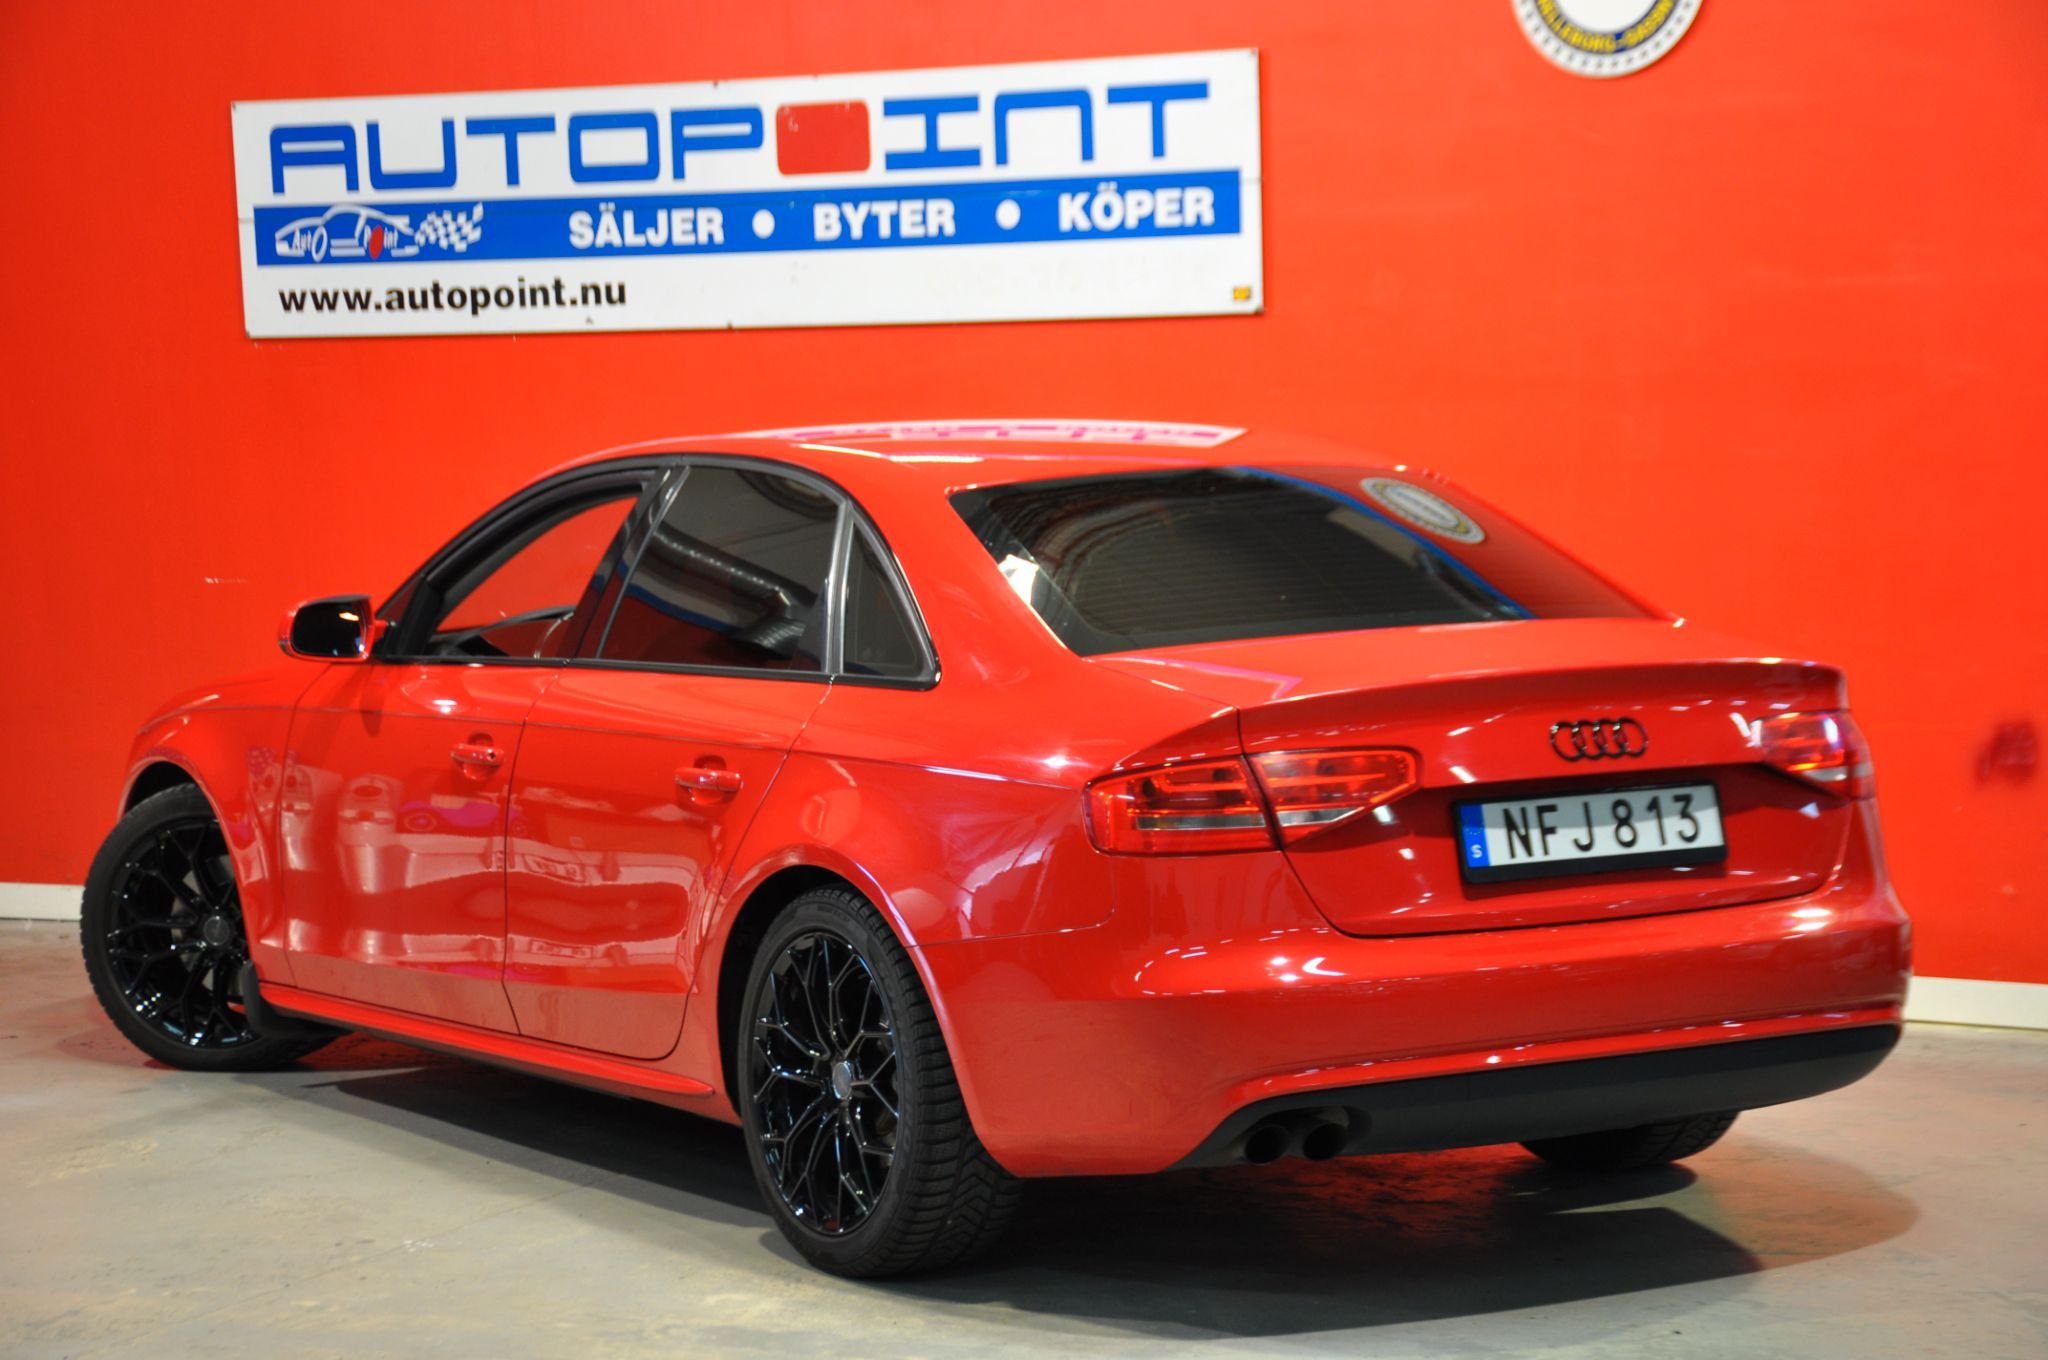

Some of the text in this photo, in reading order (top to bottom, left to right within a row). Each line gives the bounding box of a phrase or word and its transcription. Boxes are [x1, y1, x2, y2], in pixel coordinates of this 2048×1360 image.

[568, 181, 1216, 249] SÄLJER BYTER KÖPER
[278, 276, 628, 316] www.autopoint.nu
[1471, 844, 1482, 859] S
[1502, 793, 1700, 859] NFJ 813
